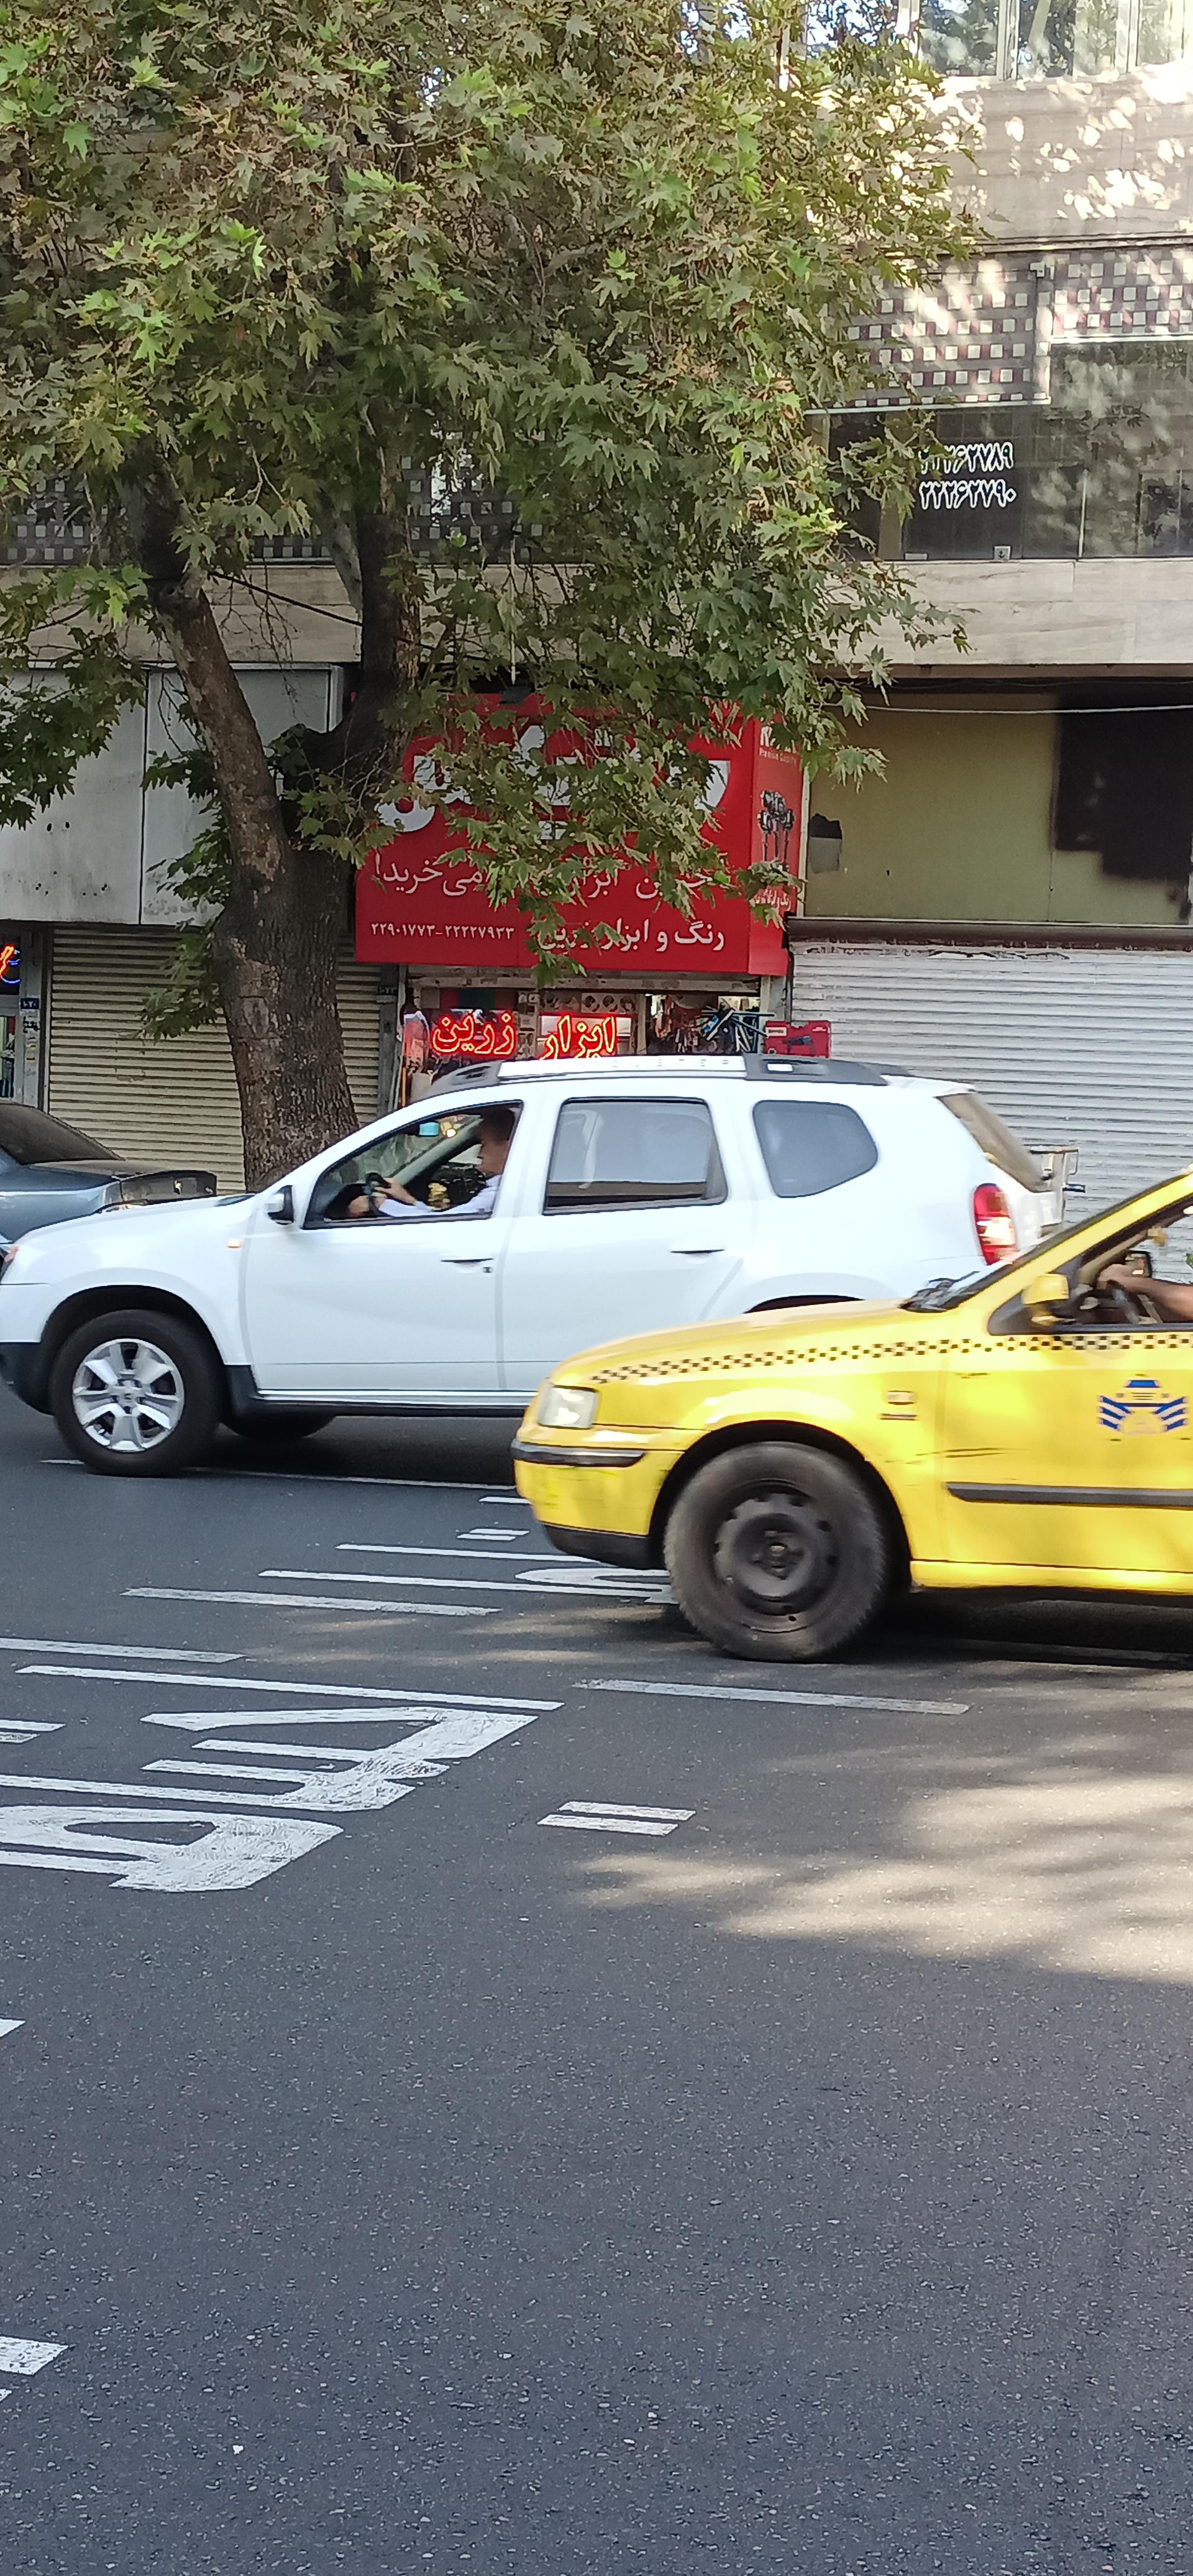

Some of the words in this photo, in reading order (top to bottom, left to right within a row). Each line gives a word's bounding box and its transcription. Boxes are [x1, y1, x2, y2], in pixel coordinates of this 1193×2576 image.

[656, 931, 668, 951] و
[674, 920, 724, 951] رنگ
[432, 1009, 514, 1054] زرین
[538, 1014, 616, 1060] ابزار
